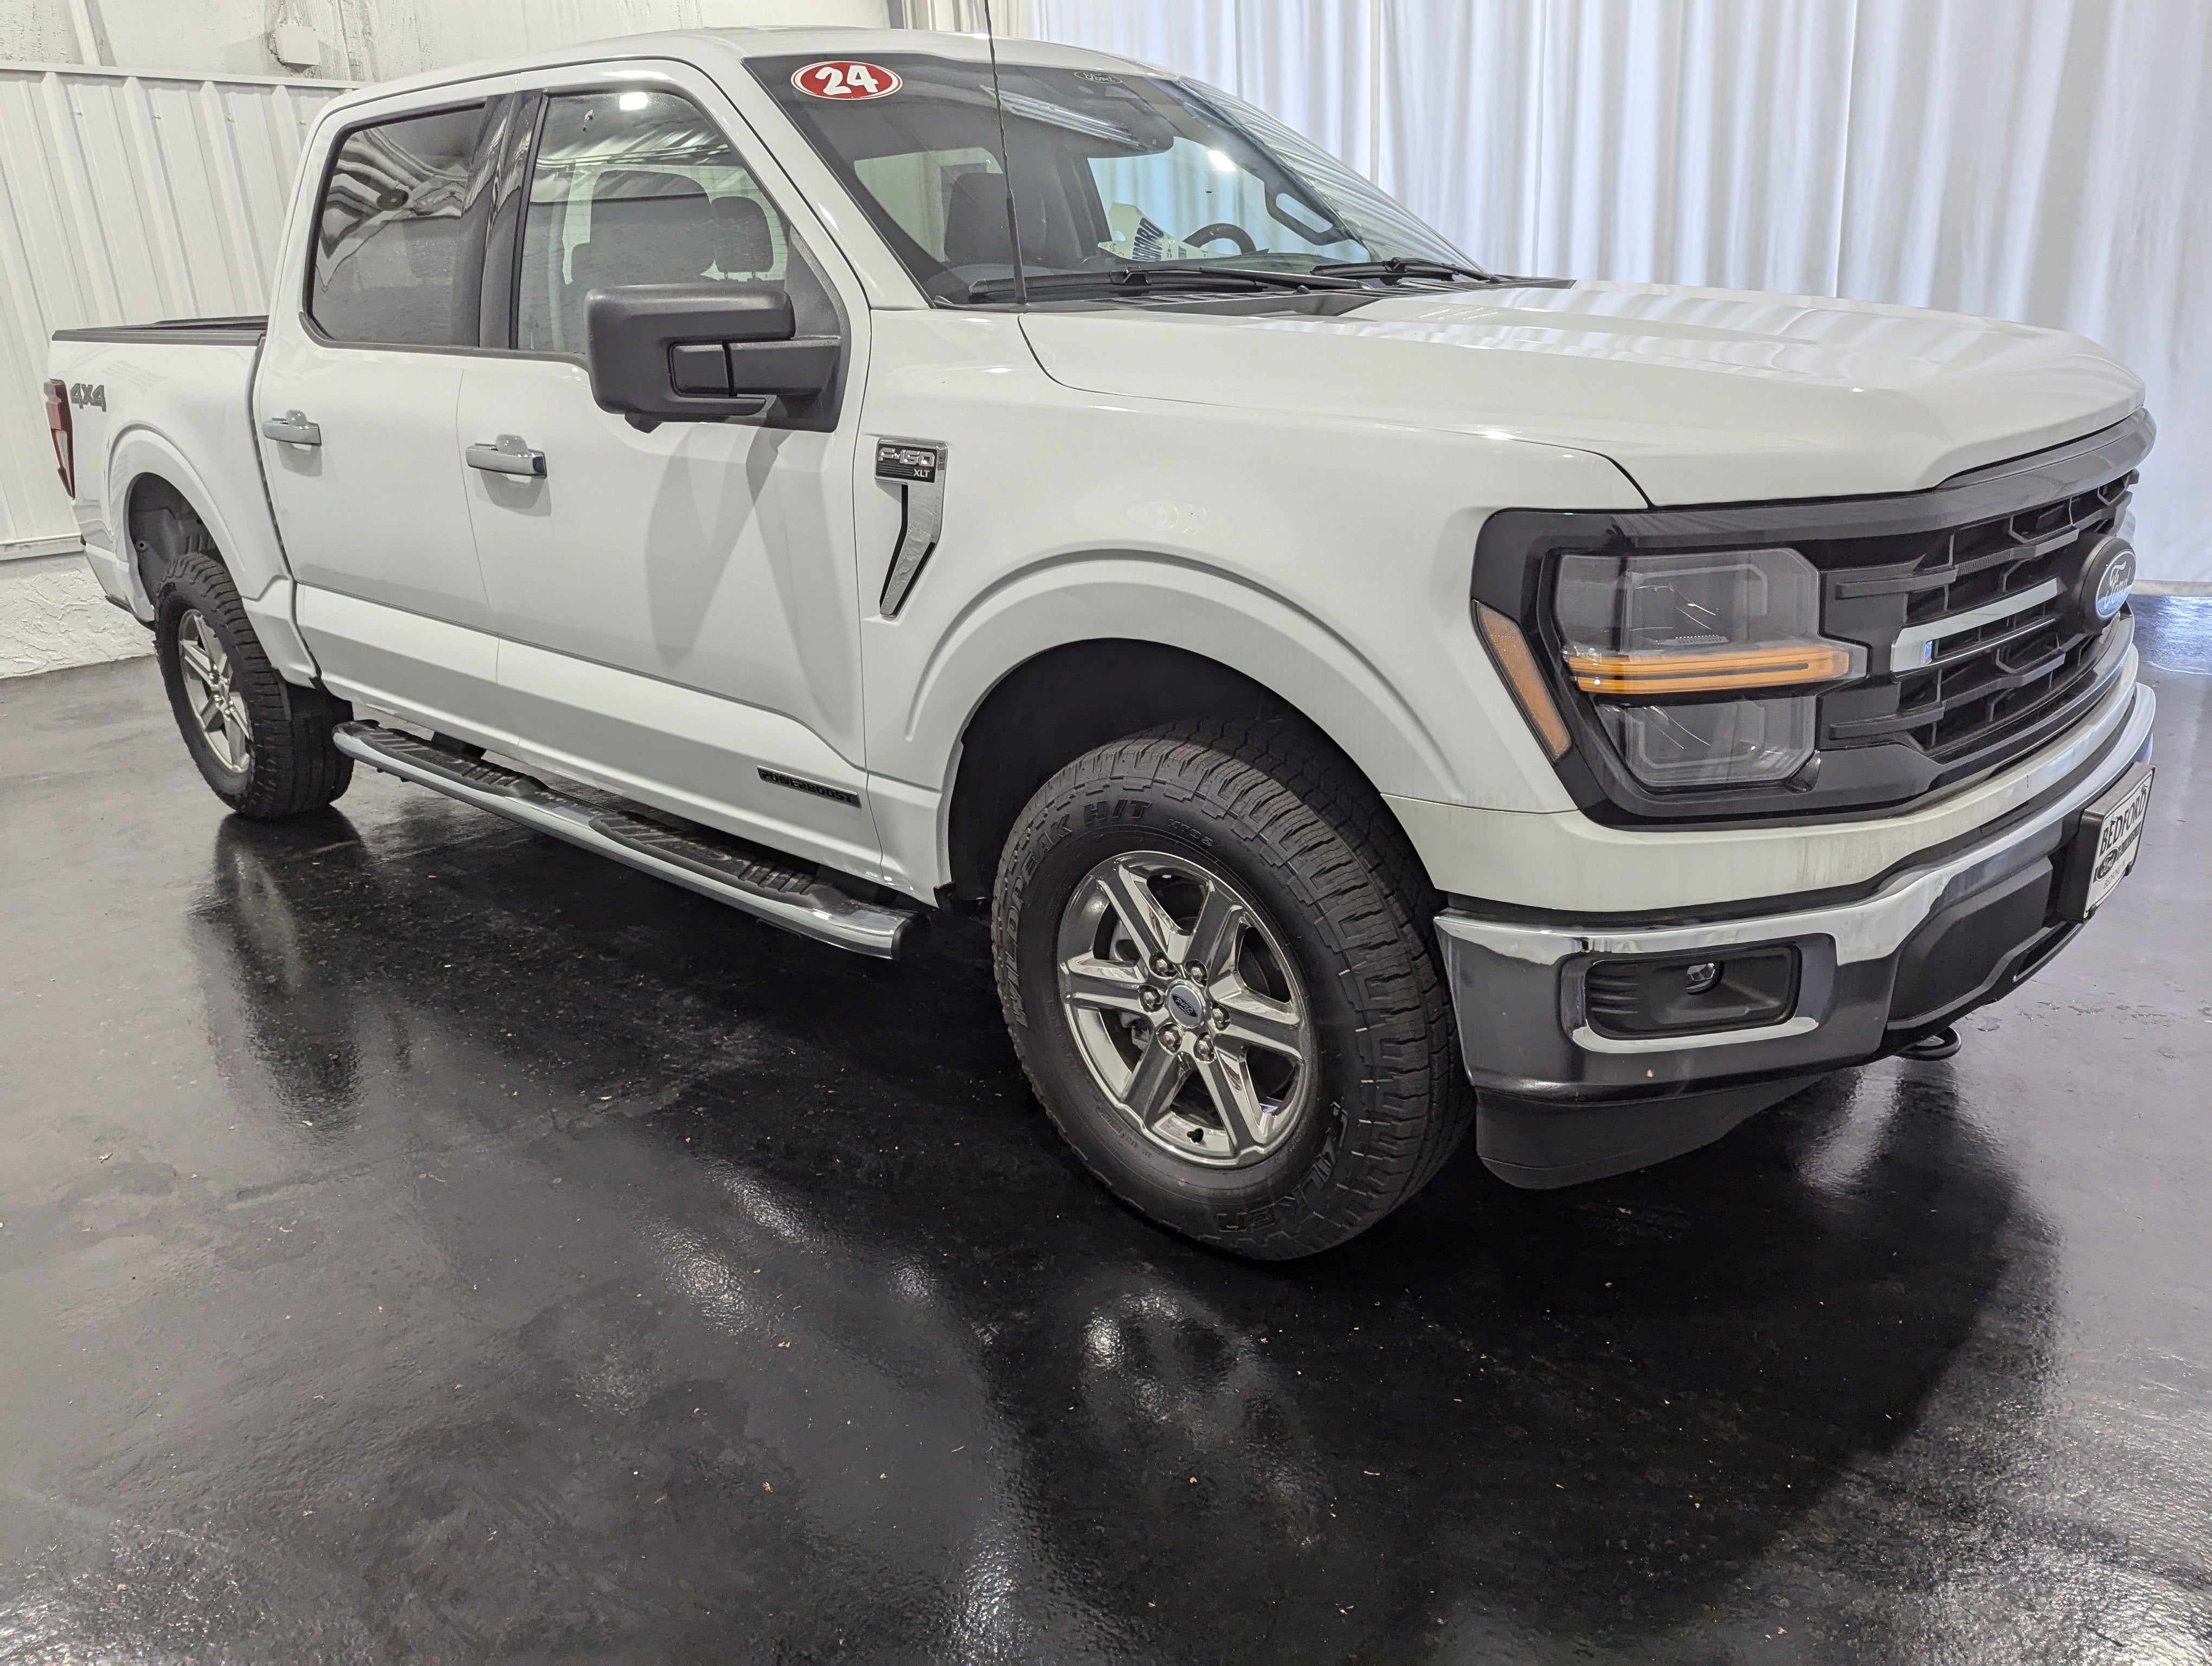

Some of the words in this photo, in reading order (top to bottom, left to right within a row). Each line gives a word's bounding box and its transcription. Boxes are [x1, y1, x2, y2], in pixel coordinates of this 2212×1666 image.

[815, 65, 879, 95] 24
[1083, 72, 1115, 82] Ford
[878, 447, 935, 467] F-150
[913, 469, 930, 478] XLT
[2104, 561, 2131, 610] Ford
[760, 770, 852, 803] POWERBOOST
[2099, 792, 2146, 858] BEDFORD
[1005, 813, 1073, 1029] WILDPEAK
[1084, 799, 1152, 826] H/T
[1175, 997, 1193, 1014] Ford
